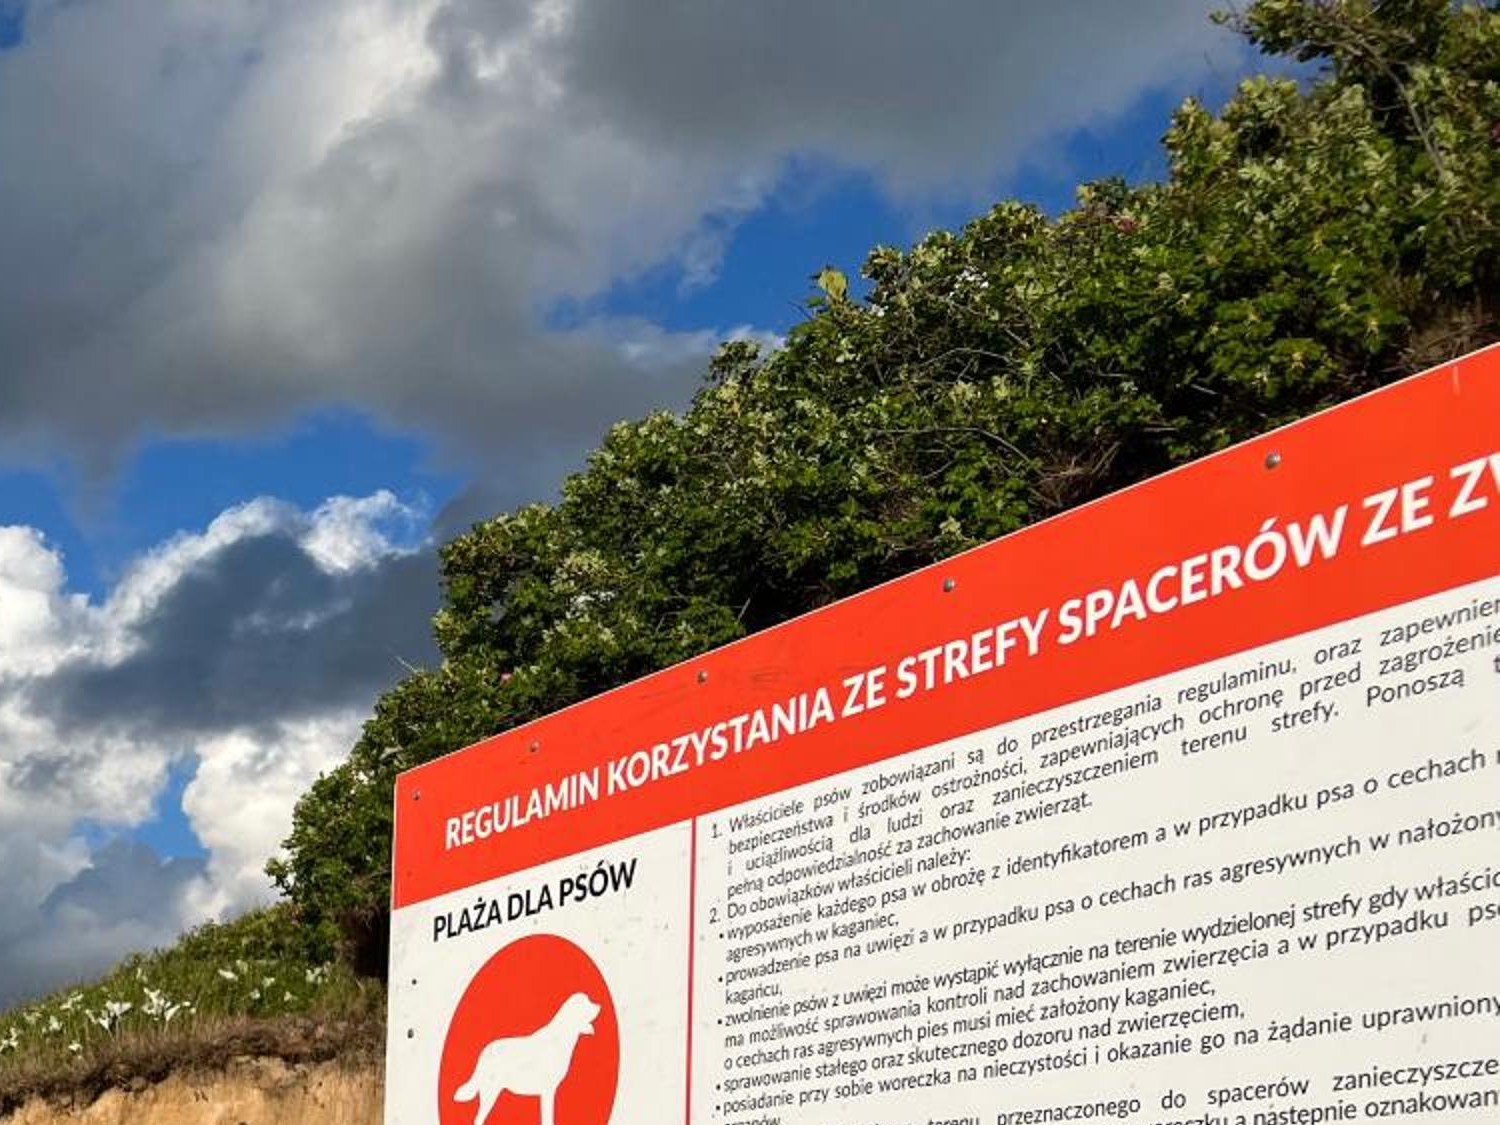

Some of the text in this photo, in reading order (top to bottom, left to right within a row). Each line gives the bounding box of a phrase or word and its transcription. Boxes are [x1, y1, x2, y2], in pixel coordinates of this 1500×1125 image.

[446, 452, 1500, 849] REGULAMIN KORZYSTANIA ZE STREFY SPACERÓW ZE Z
[895, 839, 913, 855] za
[916, 811, 1011, 850] zachowanie
[1014, 791, 1092, 825] zwierząt.
[433, 857, 638, 943] PLAŻA DLA PSÓW
[709, 907, 721, 925] 2.
[727, 902, 747, 919] Do
[837, 857, 913, 892] właścicieli
[917, 846, 971, 873] należy:
[725, 928, 813, 964] agresywnych
[815, 928, 829, 942] w
[723, 1057, 733, 1071] o
[735, 1044, 790, 1069] cechach
[793, 1044, 815, 1059] ras
[817, 1023, 913, 1058] agresywnych
[917, 1019, 949, 1043] pies
[953, 1009, 991, 1035] musi
[1039, 994, 1121, 1021] założony
[723, 1001, 1245, 1094] sprawowanie stałego oraz skutecznego dozoru nad zwierzęciem,
[1161, 1089, 1187, 1111] do
[1207, 1076, 1310, 1109] spacerów
[1332, 1046, 1500, 1092] zanieczyszcze
